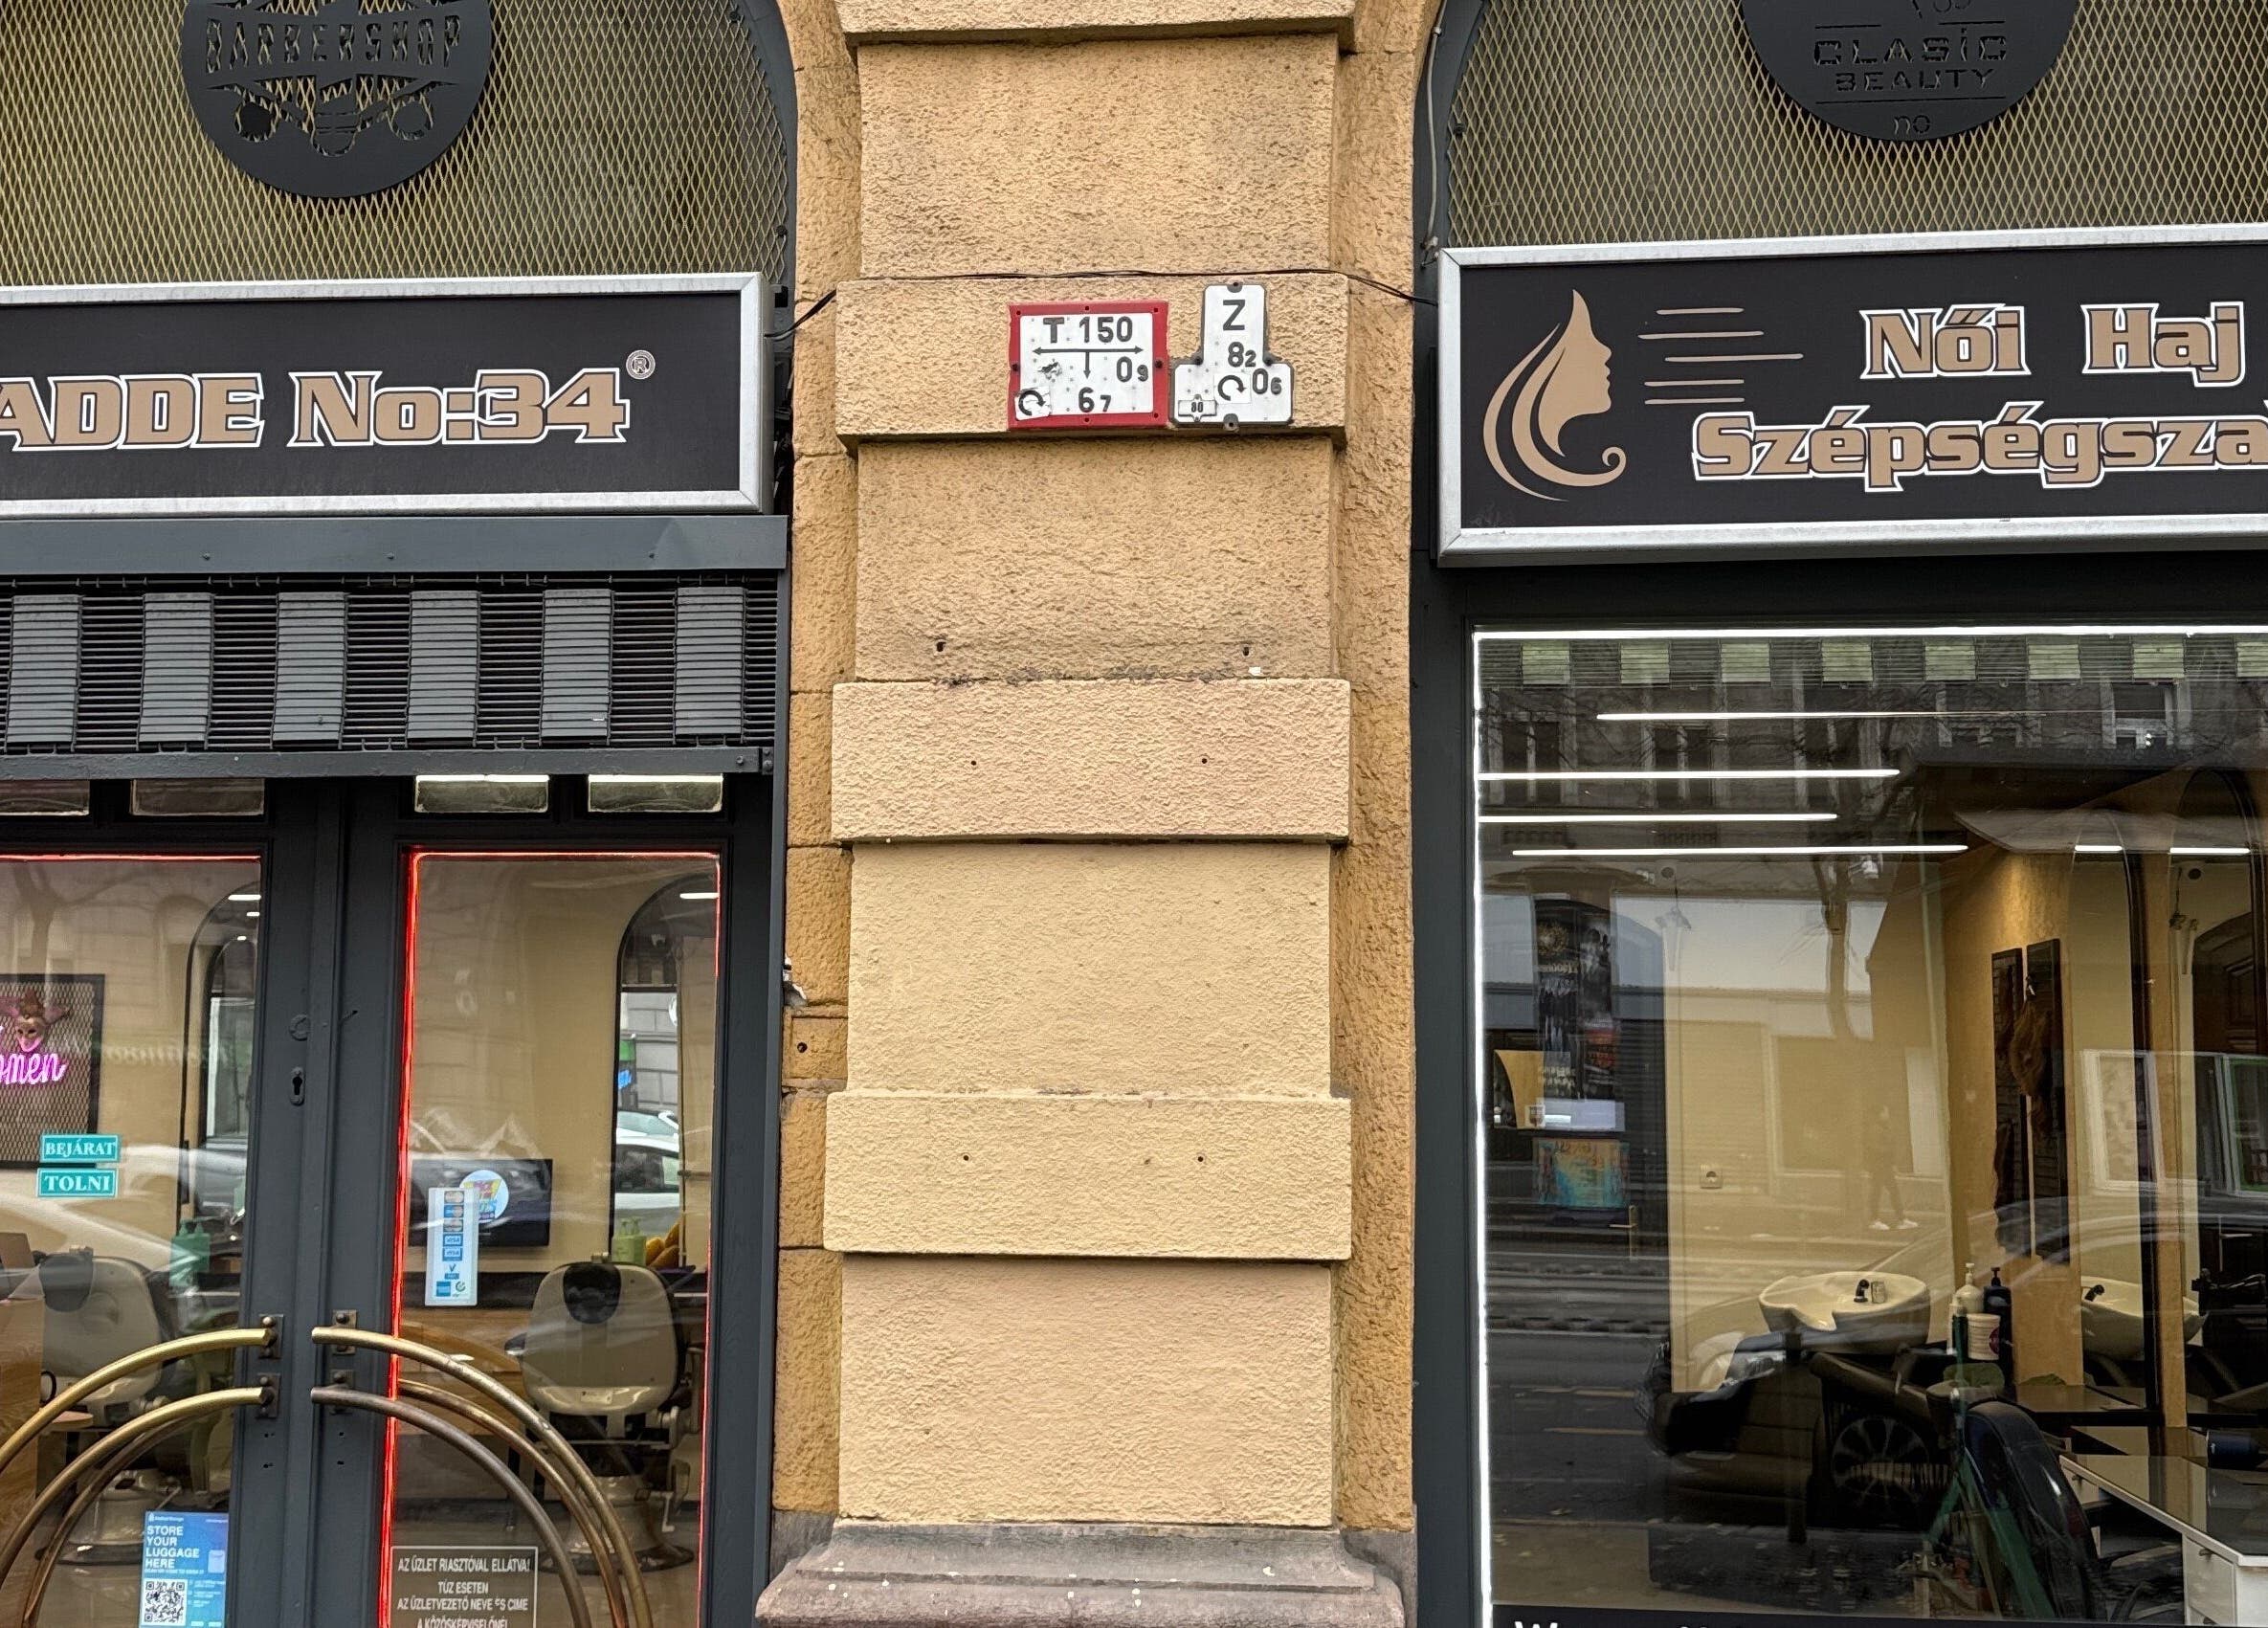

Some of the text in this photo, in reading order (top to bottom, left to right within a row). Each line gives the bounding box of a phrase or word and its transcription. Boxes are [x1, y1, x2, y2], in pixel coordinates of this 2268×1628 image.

[206, 15, 459, 74] BARBERSHOP
[1835, 68, 1994, 92] BEAUTY
[1222, 299, 1246, 331] Z
[1042, 315, 1133, 344] T 150
[1858, 301, 2245, 388] Női Haj
[1692, 400, 2268, 493] Szépségsza
[0, 1053, 69, 1085] men
[47, 1138, 117, 1157] BEJÁRAT
[44, 1175, 112, 1192] TOLNI
[146, 1525, 184, 1536] STORE
[146, 1536, 178, 1547] YOUR
[145, 1548, 200, 1559] LUGGAGE
[145, 1558, 175, 1569] HERE
[398, 1557, 410, 1572] AZ
[438, 1554, 489, 1572] RIASZTÓVAL
[456, 1581, 489, 1595] ESETEN
[397, 1598, 409, 1611] AZ
[470, 1597, 493, 1611] NEVE
